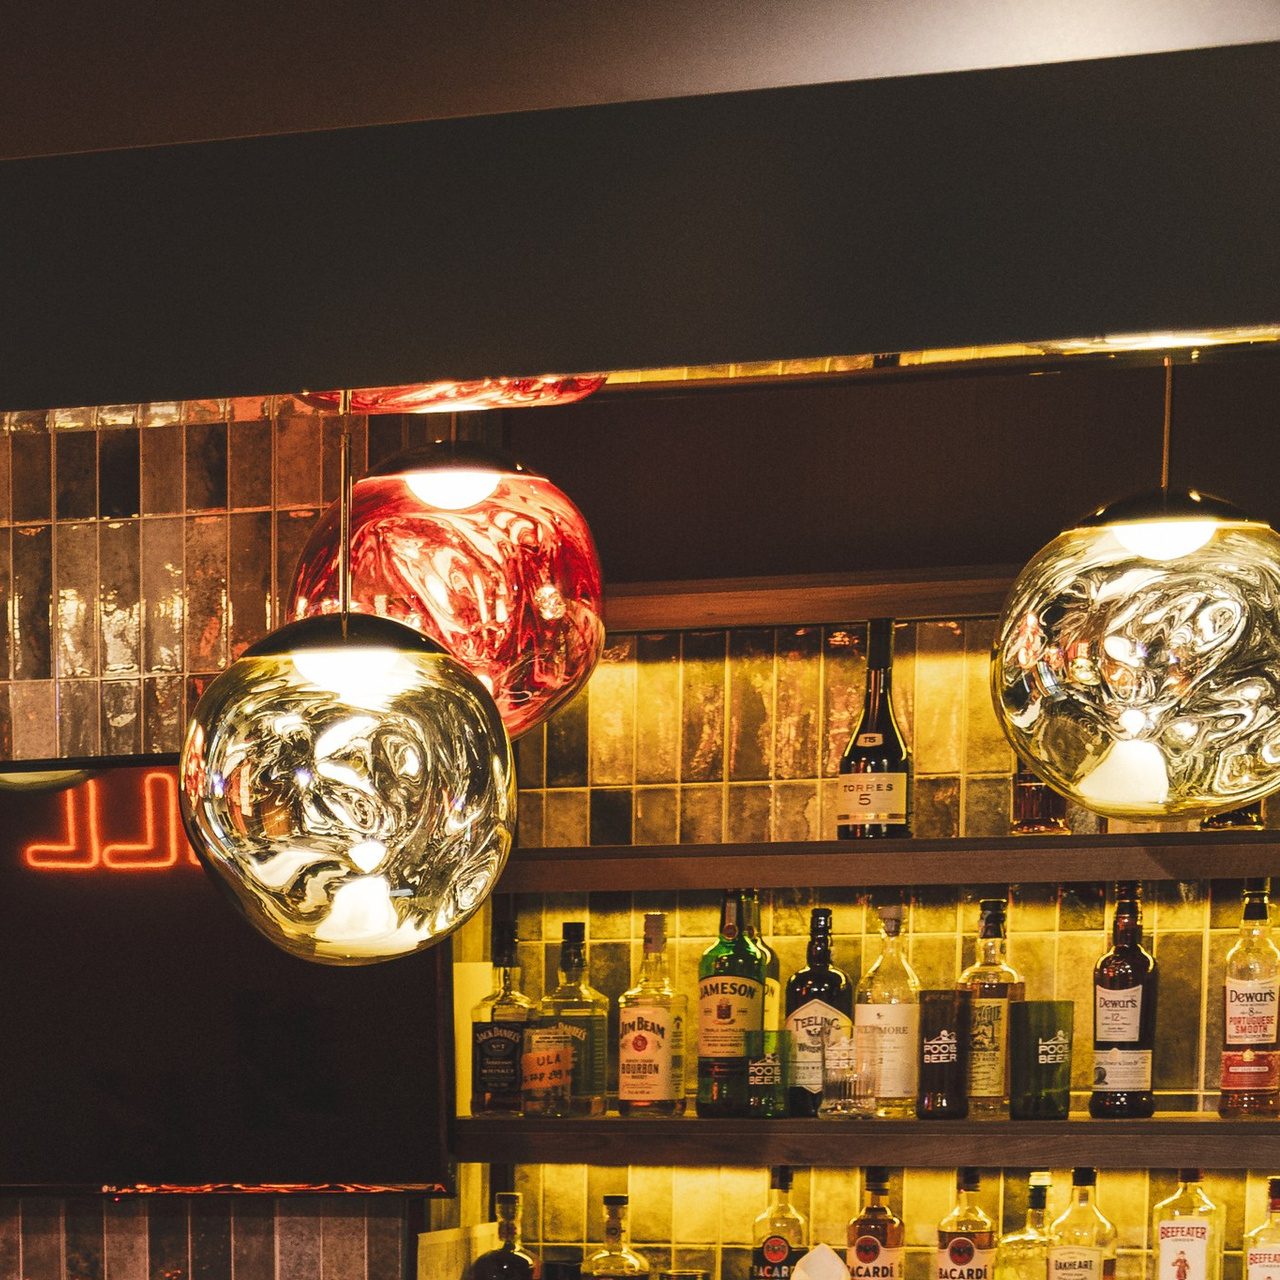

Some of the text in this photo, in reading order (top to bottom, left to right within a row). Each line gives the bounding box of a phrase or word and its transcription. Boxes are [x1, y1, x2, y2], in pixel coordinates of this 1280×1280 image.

[843, 783, 894, 793] TORRES
[858, 793, 872, 806] 5
[1098, 996, 1138, 1009] Dewar's
[1229, 989, 1276, 1004] Dewar's
[1110, 1012, 1120, 1022] 12
[1229, 1016, 1275, 1025] PORTUGUESE
[620, 1016, 666, 1039] JIM BEAM
[793, 1016, 842, 1031] TEELING
[1235, 1025, 1268, 1034] SMOOTH
[476, 1029, 494, 1044] JACK
[923, 1054, 958, 1064] BEER
[1038, 1054, 1070, 1064] BEER
[621, 1063, 660, 1075] BOURBON
[748, 1076, 781, 1085] BEER
[1160, 1226, 1207, 1241] BEEFEATER
[938, 1265, 988, 1280] BACARDÍ
